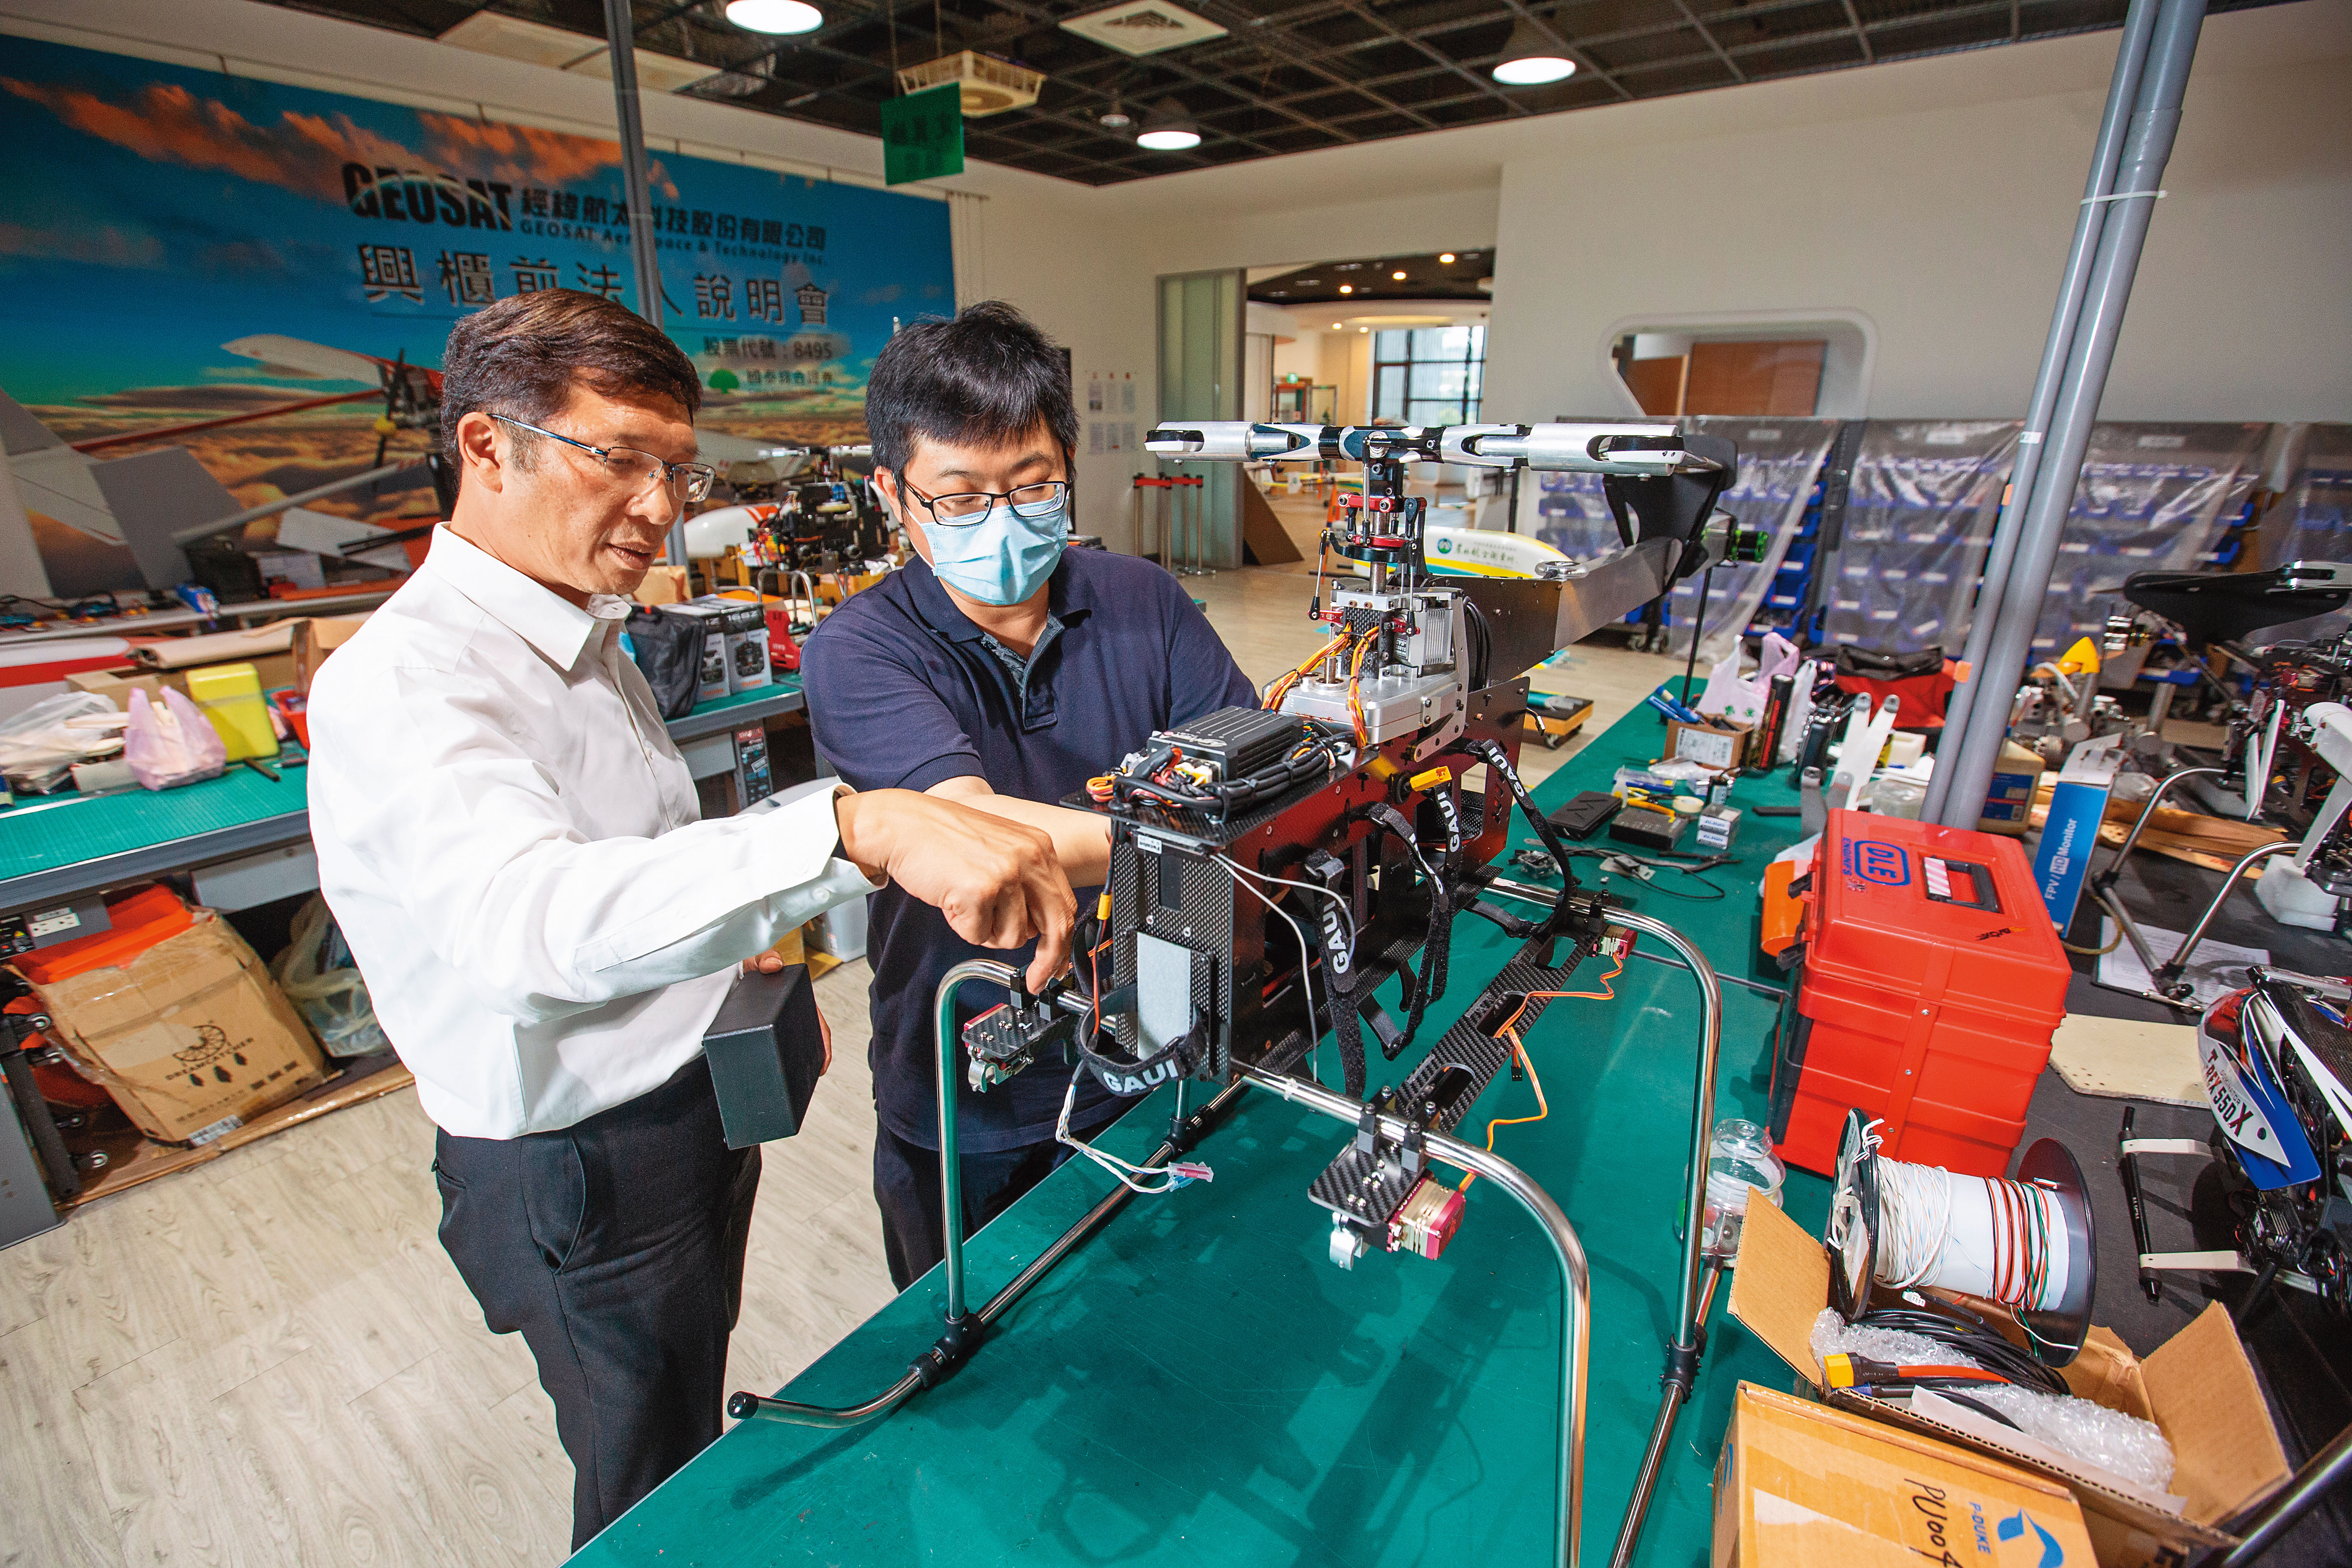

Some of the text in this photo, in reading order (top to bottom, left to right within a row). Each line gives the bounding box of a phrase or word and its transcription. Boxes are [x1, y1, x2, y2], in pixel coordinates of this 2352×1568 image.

[342, 162, 512, 232] GEOSAT
[602, 229, 692, 251] Aerpace
[1488, 746, 1526, 797] GAUI
[1436, 791, 1460, 853] GAUI
[1866, 846, 1897, 879] DLE
[1323, 900, 1349, 974] GAUI
[1102, 1059, 1178, 1094] GAUI
[1969, 1501, 1992, 1555] P-DUKE
